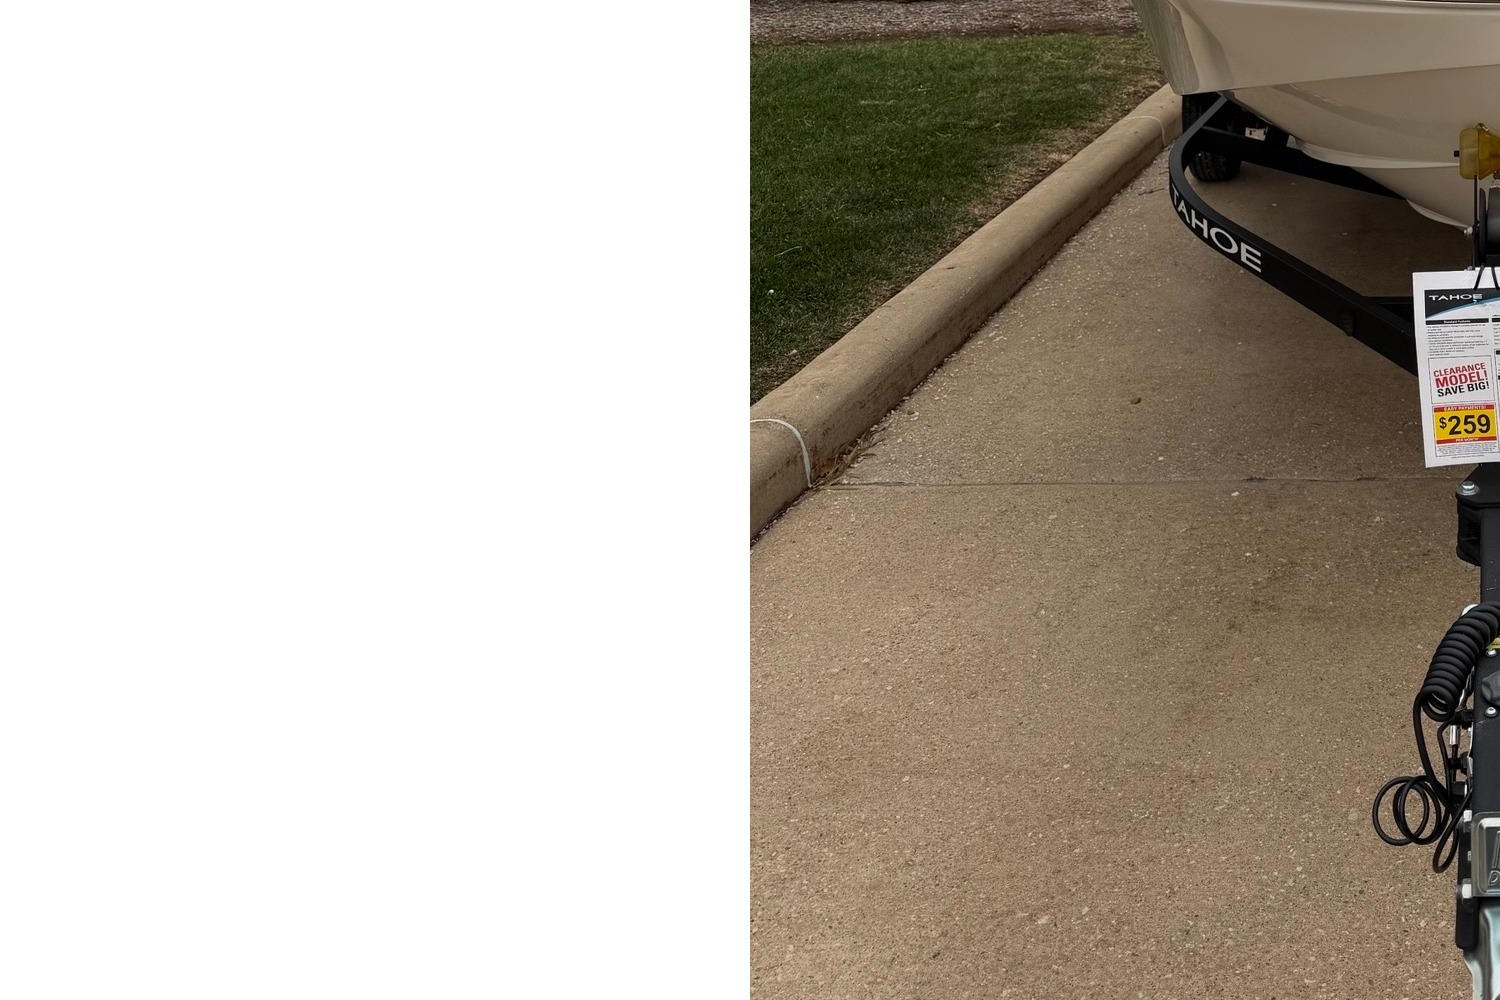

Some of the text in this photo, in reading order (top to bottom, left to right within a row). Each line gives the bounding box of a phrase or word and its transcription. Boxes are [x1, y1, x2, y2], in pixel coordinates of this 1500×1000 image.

[1171, 183, 1262, 273] TAHOE
[1428, 293, 1483, 301] TAHOE
[1433, 362, 1486, 377] CLEARANCE
[1435, 370, 1488, 388] MODEL!
[1437, 381, 1490, 397] SAVE BIG!
[1439, 414, 1491, 435] $259
